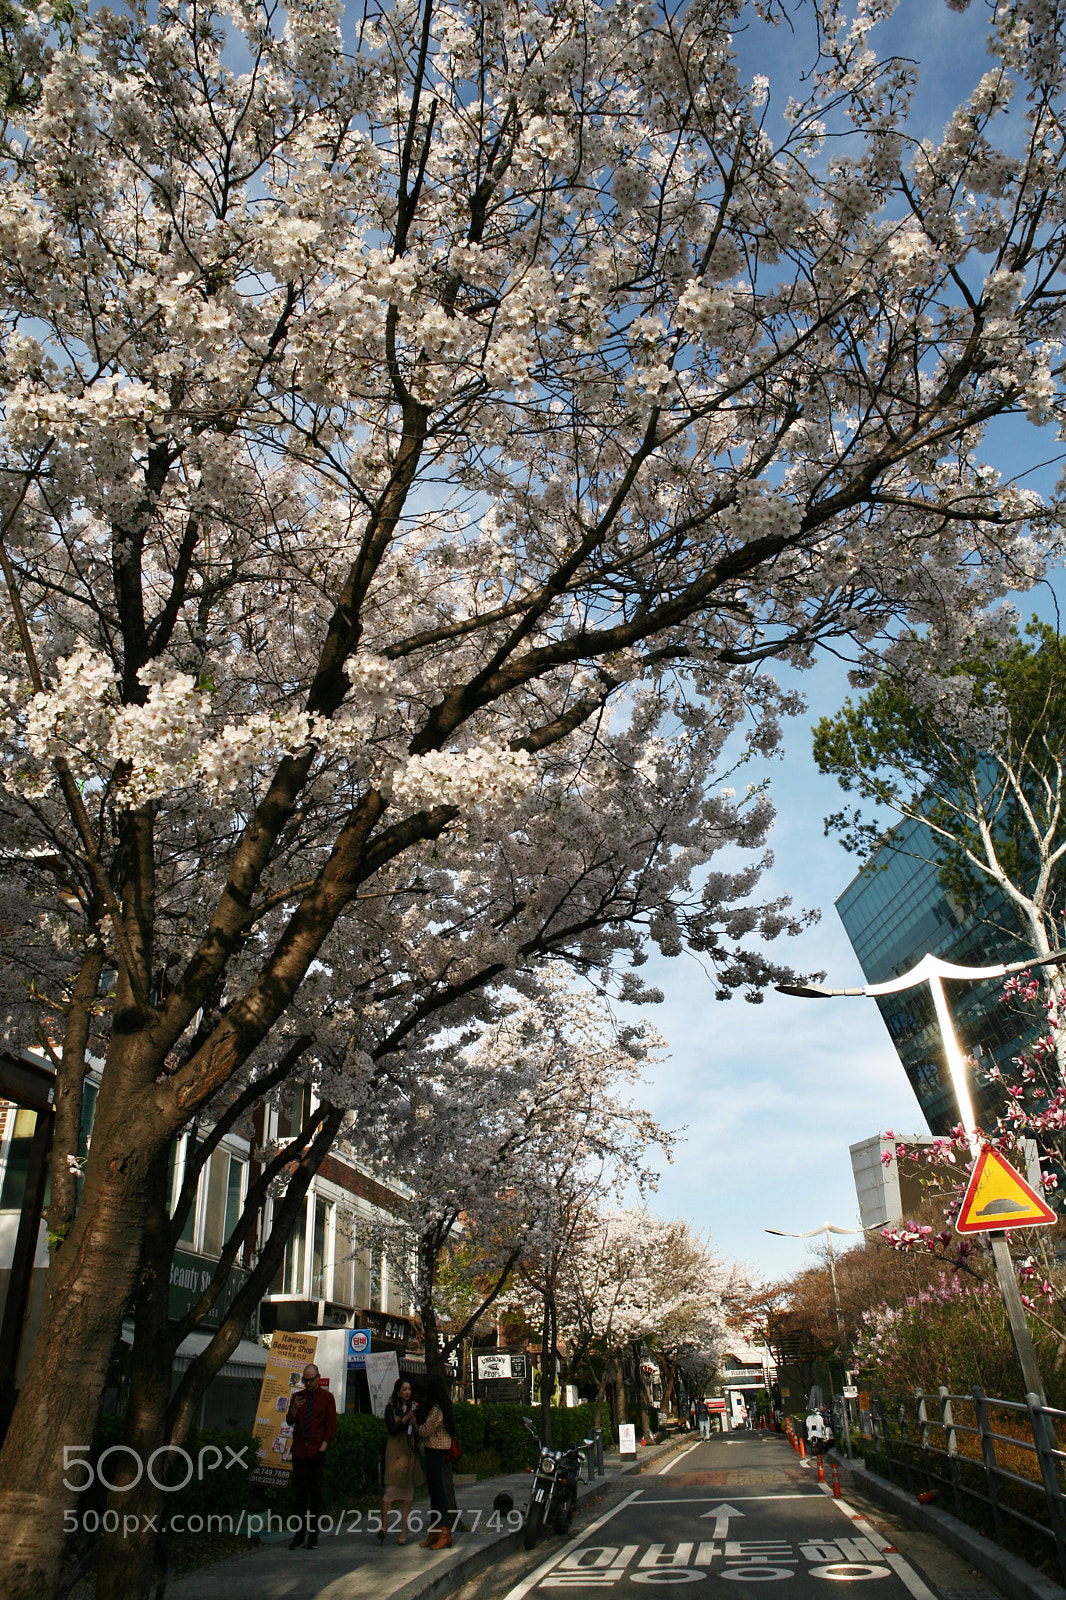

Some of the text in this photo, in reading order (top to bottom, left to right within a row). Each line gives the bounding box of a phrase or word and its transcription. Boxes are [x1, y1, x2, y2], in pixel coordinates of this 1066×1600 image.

[281, 1334, 308, 1345] Itaewon
[353, 1337, 367, 1346] 담배
[272, 1341, 314, 1355] Beauty Shop
[481, 1356, 506, 1365] UNKNOWN
[483, 1370, 506, 1378] PEOPLE
[539, 1537, 892, 1588] 일방통행
